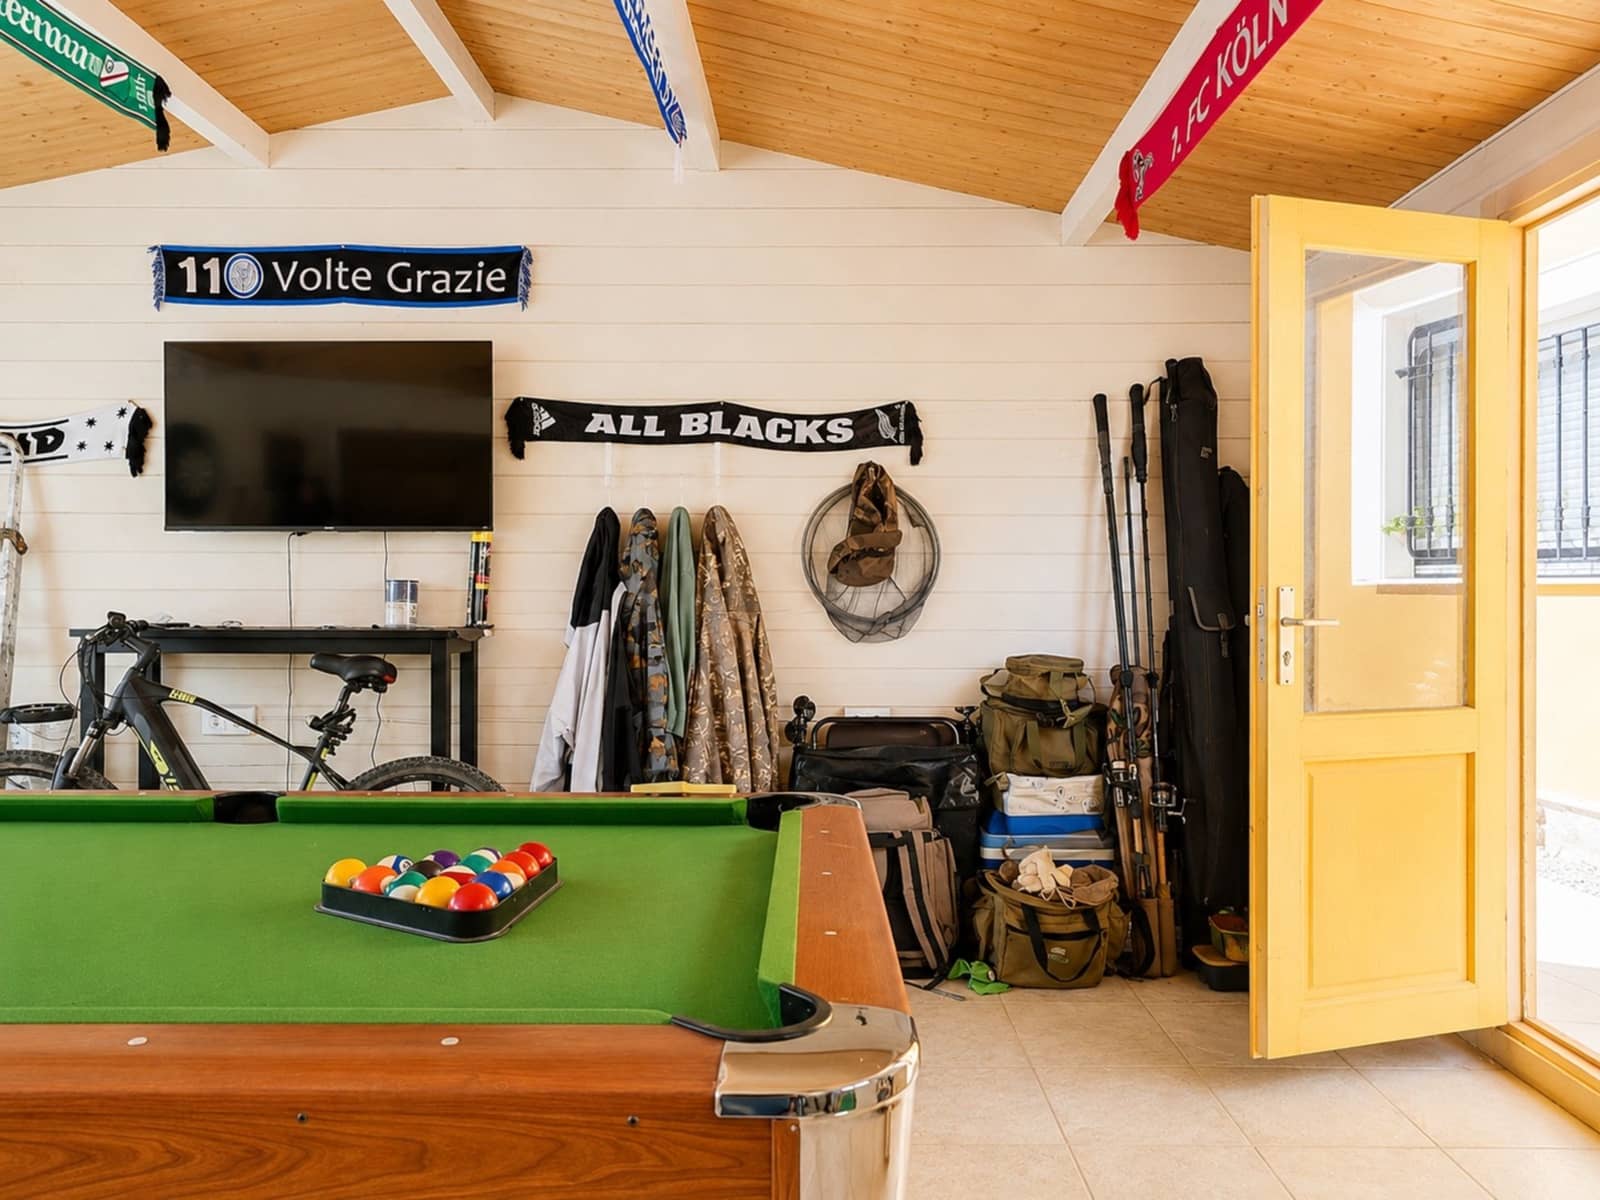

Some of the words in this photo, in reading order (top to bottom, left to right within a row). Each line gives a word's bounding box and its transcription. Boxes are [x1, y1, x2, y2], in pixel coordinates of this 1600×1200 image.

[1171, 125, 1182, 163] 1.
[1186, 76, 1210, 143] FC
[1216, 0, 1288, 99] KÖLN
[272, 257, 372, 292] Volte
[386, 261, 507, 294] Grazie
[584, 412, 666, 437] ALL
[680, 410, 855, 444] BLACKS
